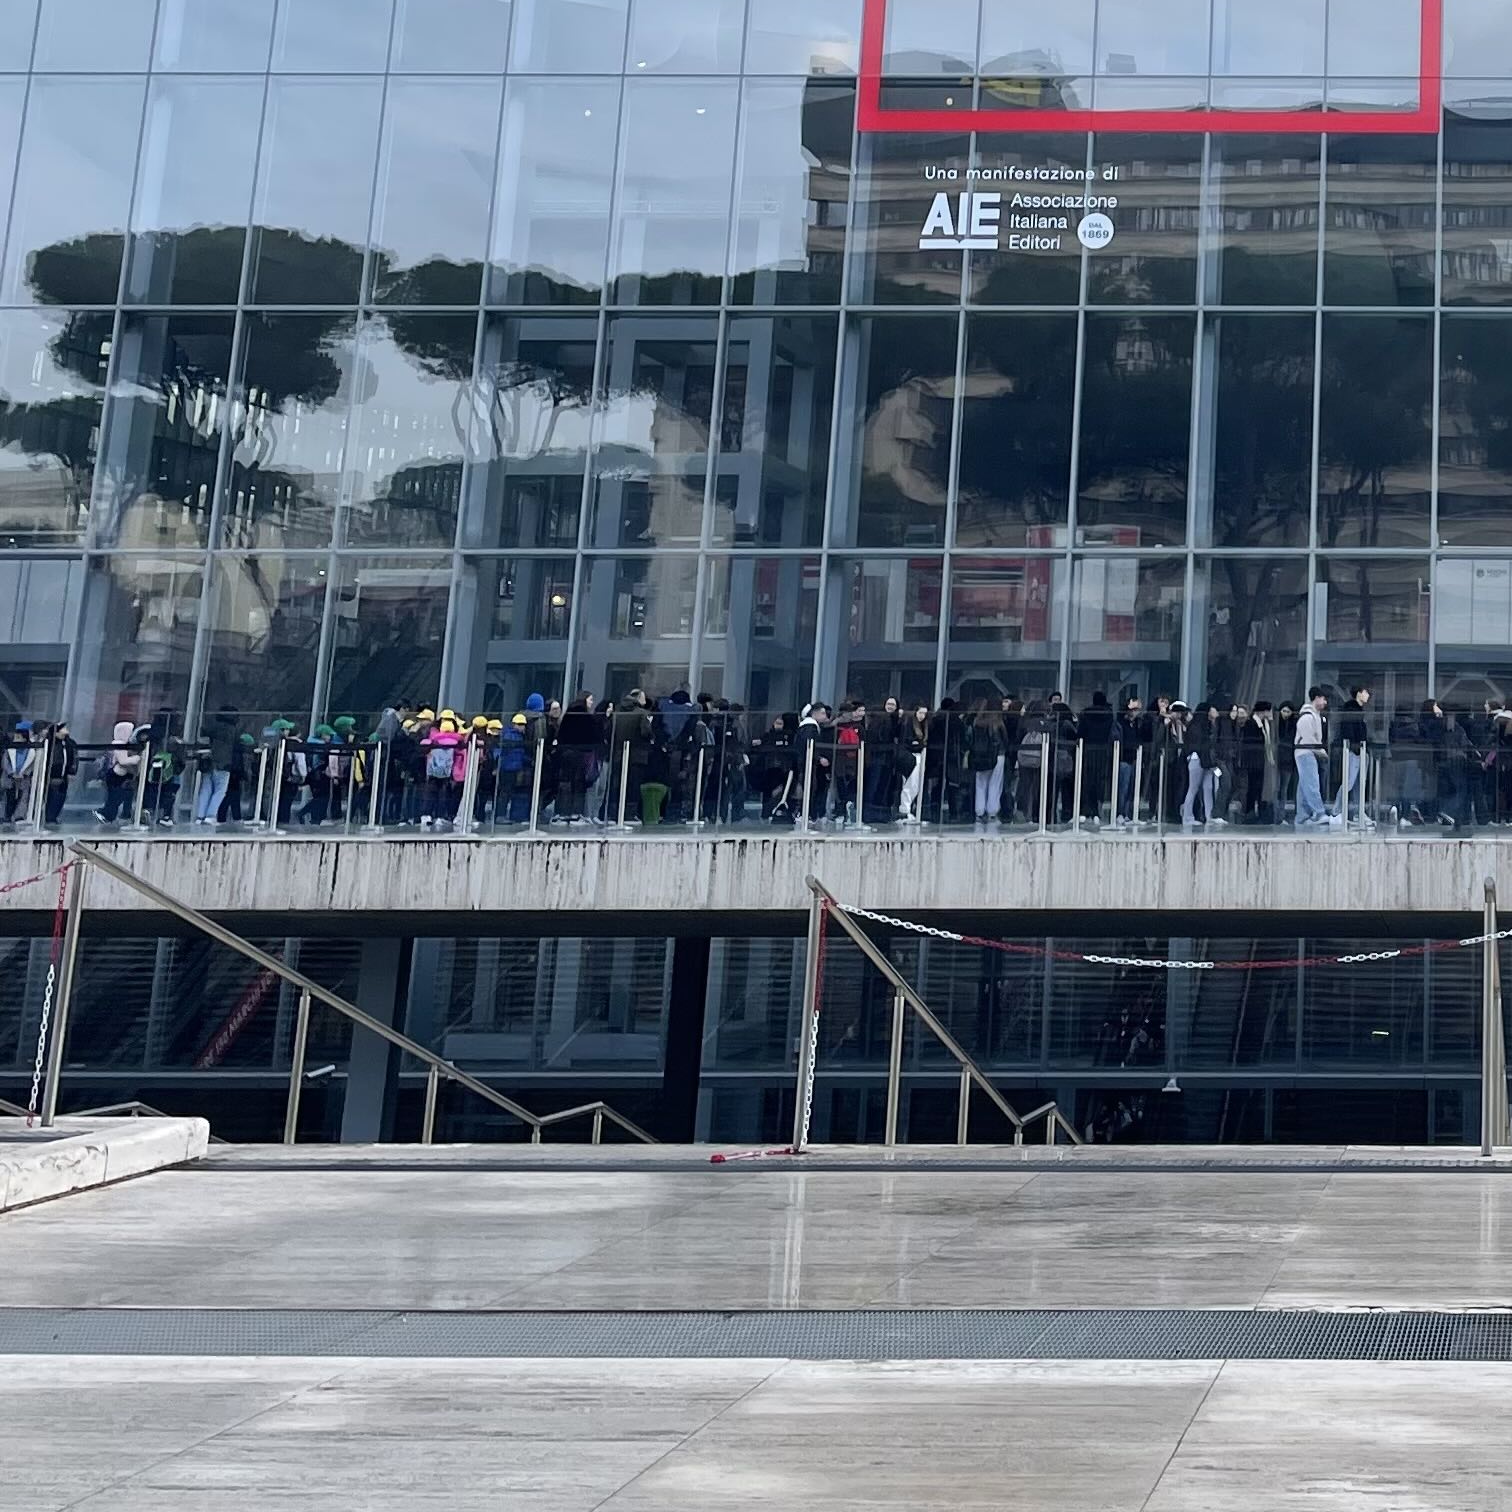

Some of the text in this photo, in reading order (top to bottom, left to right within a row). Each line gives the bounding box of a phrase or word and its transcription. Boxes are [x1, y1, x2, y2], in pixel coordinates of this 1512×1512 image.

[925, 166, 1119, 180] Una manifestazione di
[1010, 192, 1118, 209] Associazione
[921, 192, 1001, 236] AIE
[1010, 213, 1068, 230] Italiana
[1009, 234, 1061, 250] Editori
[1082, 230, 1109, 239] 1869
